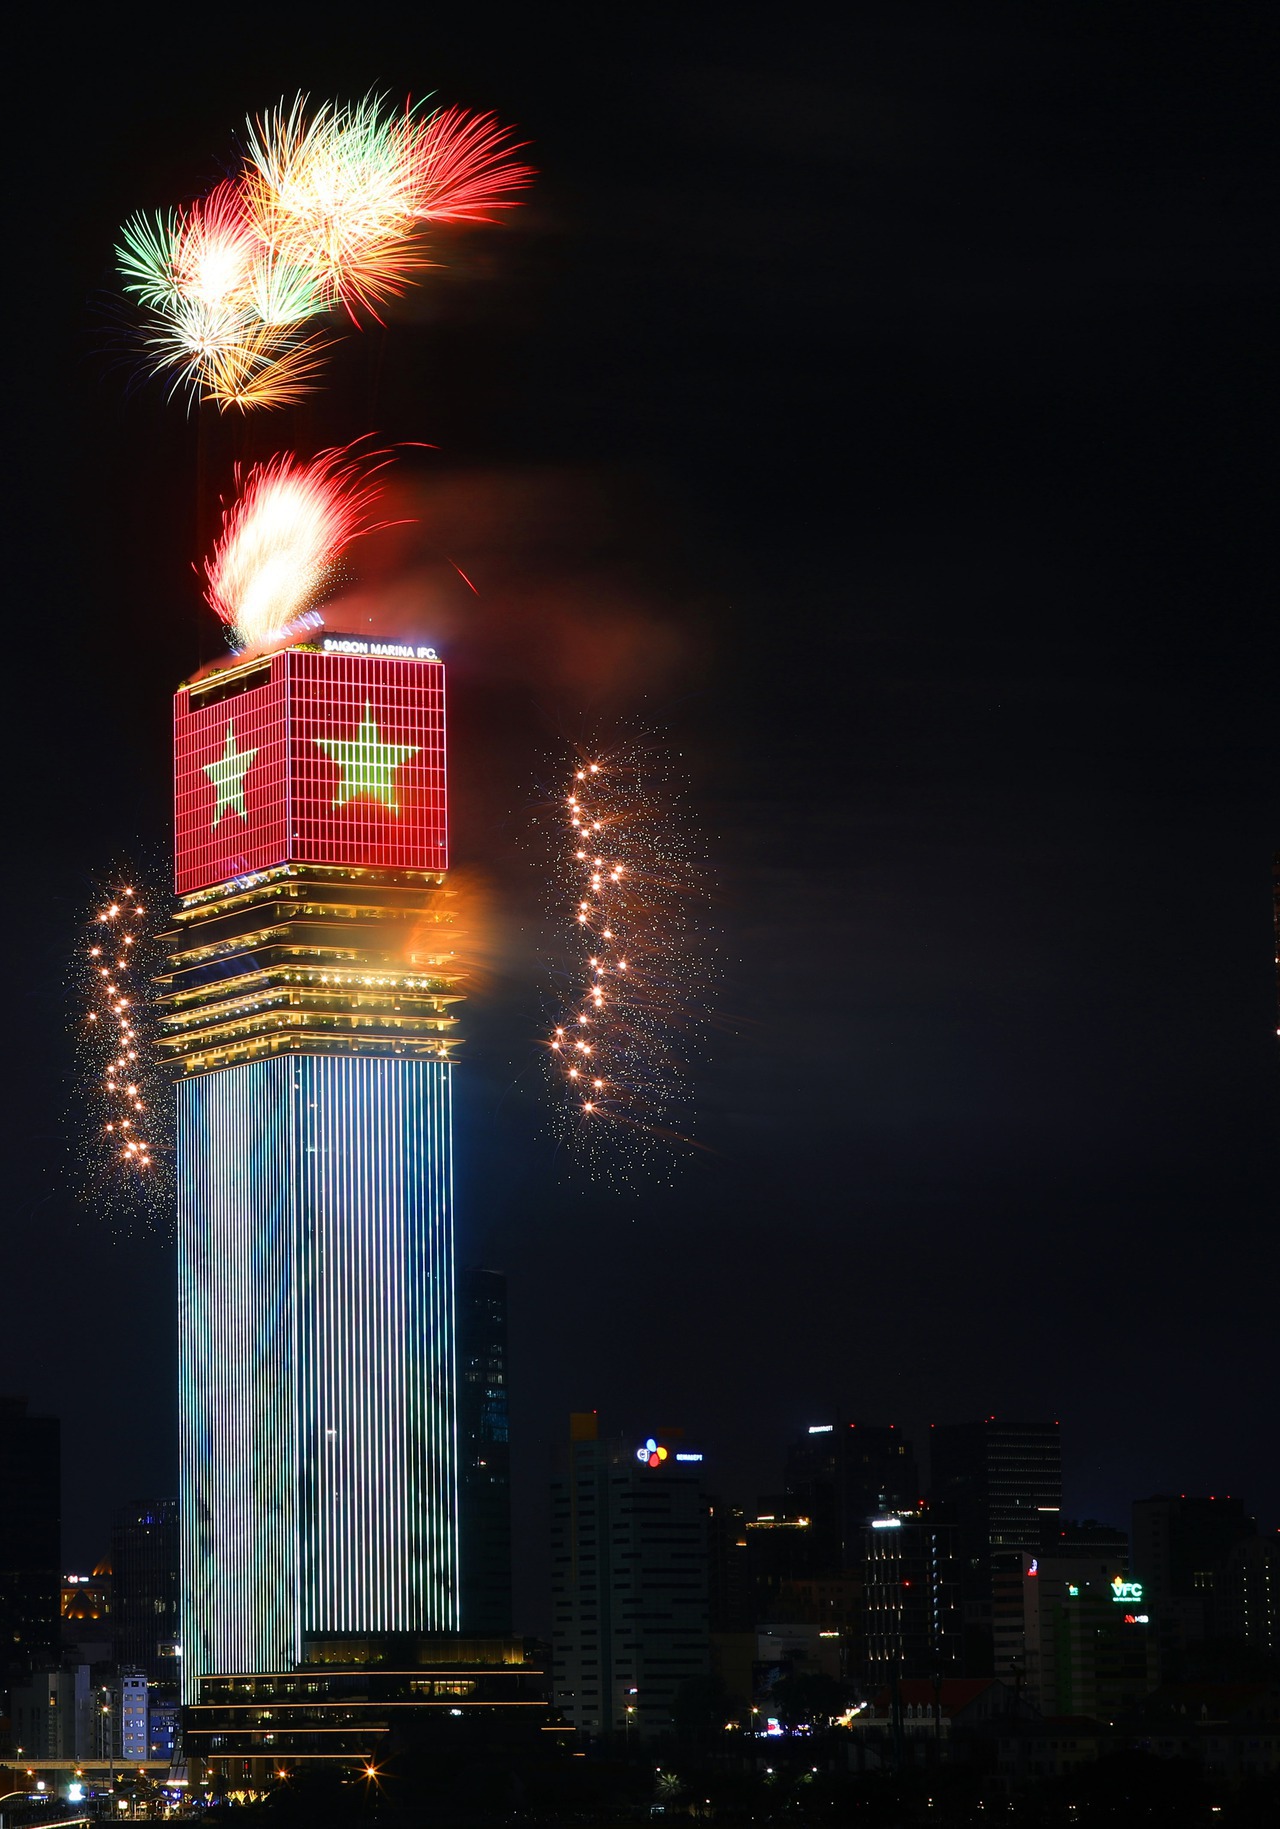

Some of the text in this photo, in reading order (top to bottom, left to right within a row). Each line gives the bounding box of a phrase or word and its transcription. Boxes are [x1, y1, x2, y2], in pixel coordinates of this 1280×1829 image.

[323, 639, 368, 654] SAIGON
[370, 643, 415, 657] MARINA
[1110, 1582, 1143, 1597] VFC
